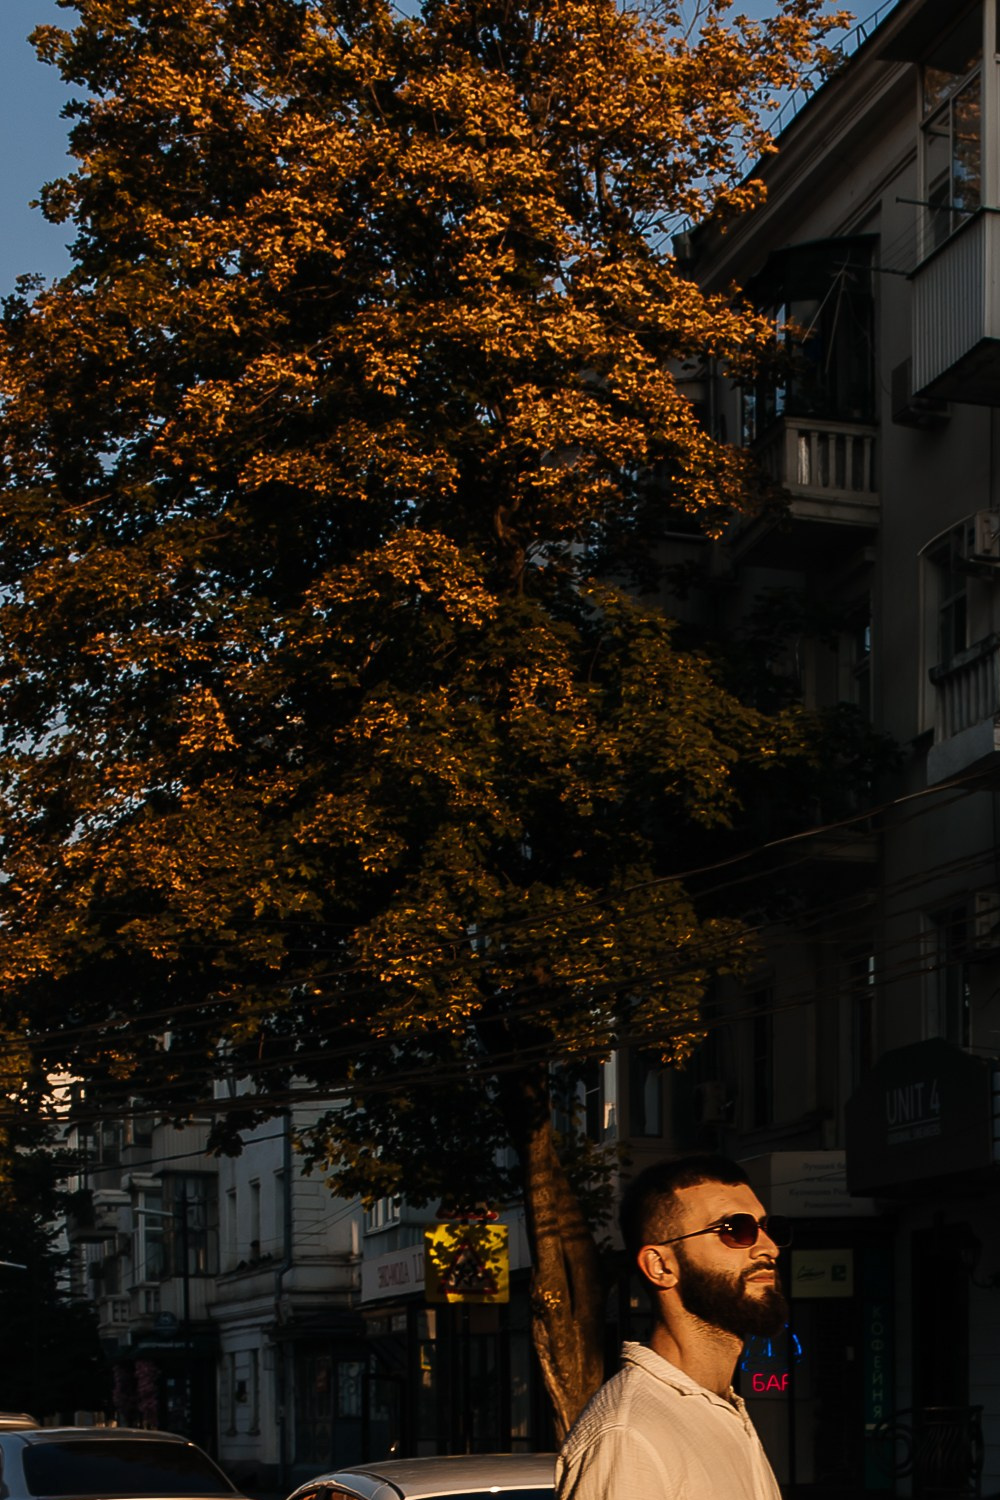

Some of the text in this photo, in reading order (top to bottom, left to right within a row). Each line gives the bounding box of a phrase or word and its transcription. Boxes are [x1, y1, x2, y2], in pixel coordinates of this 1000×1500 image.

[886, 1078, 941, 1125] UNIT 4
[870, 1304, 885, 1419] КОФЕЙНЯ
